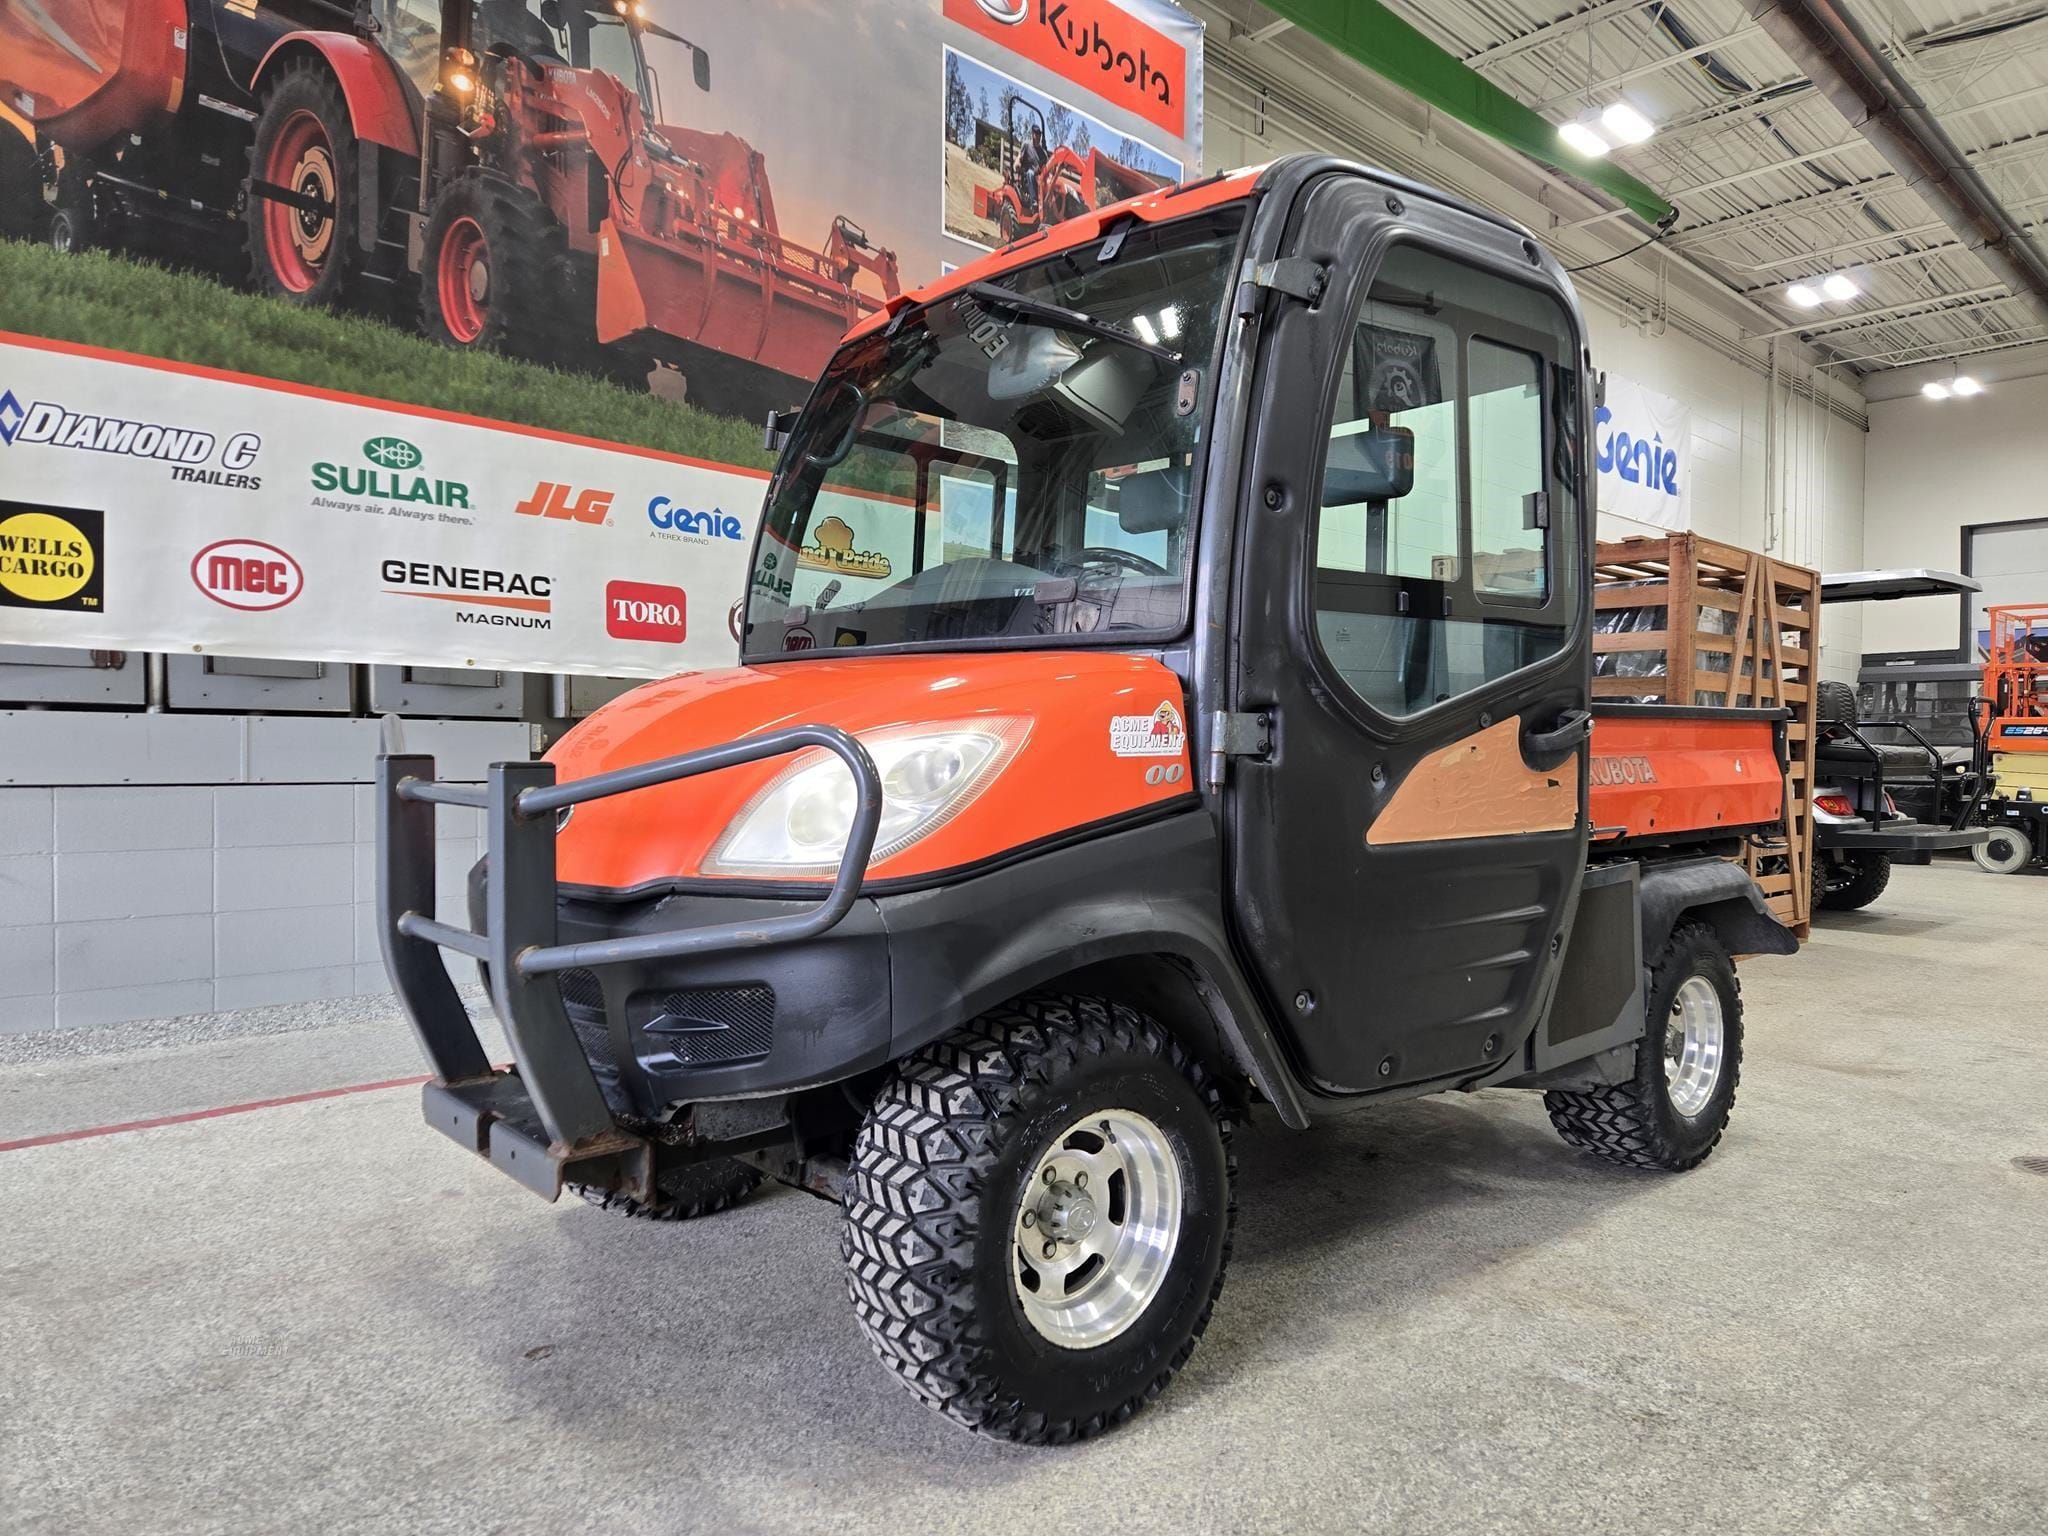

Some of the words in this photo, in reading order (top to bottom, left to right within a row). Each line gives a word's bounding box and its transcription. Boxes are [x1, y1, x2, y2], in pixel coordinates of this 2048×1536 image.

[1040, 0, 1170, 105] Kubota
[15, 401, 215, 464] DIAMOND
[221, 432, 261, 471] C
[1594, 406, 1678, 496] Genie
[171, 466, 262, 490] TRAILERS
[311, 461, 469, 510] SULLAIR
[311, 496, 361, 513] Always
[364, 504, 384, 515] air.
[388, 506, 435, 521] Always
[438, 513, 473, 525] there.
[515, 481, 615, 525] JLG
[648, 496, 742, 540] Genie
[0, 534, 82, 558] WELLS
[658, 532, 681, 542] TEREX
[682, 536, 709, 545] BRAND
[0, 555, 84, 579] CARGO
[842, 549, 889, 571] Pride
[382, 560, 551, 597] GENERAC
[81, 597, 98, 606] TM
[613, 599, 681, 626] TORO
[456, 612, 551, 629] MAGNUM
[1111, 717, 1149, 733] ACME
[1112, 734, 1184, 749] EQUIPMENT
[1590, 756, 1658, 786] KUBOTA
